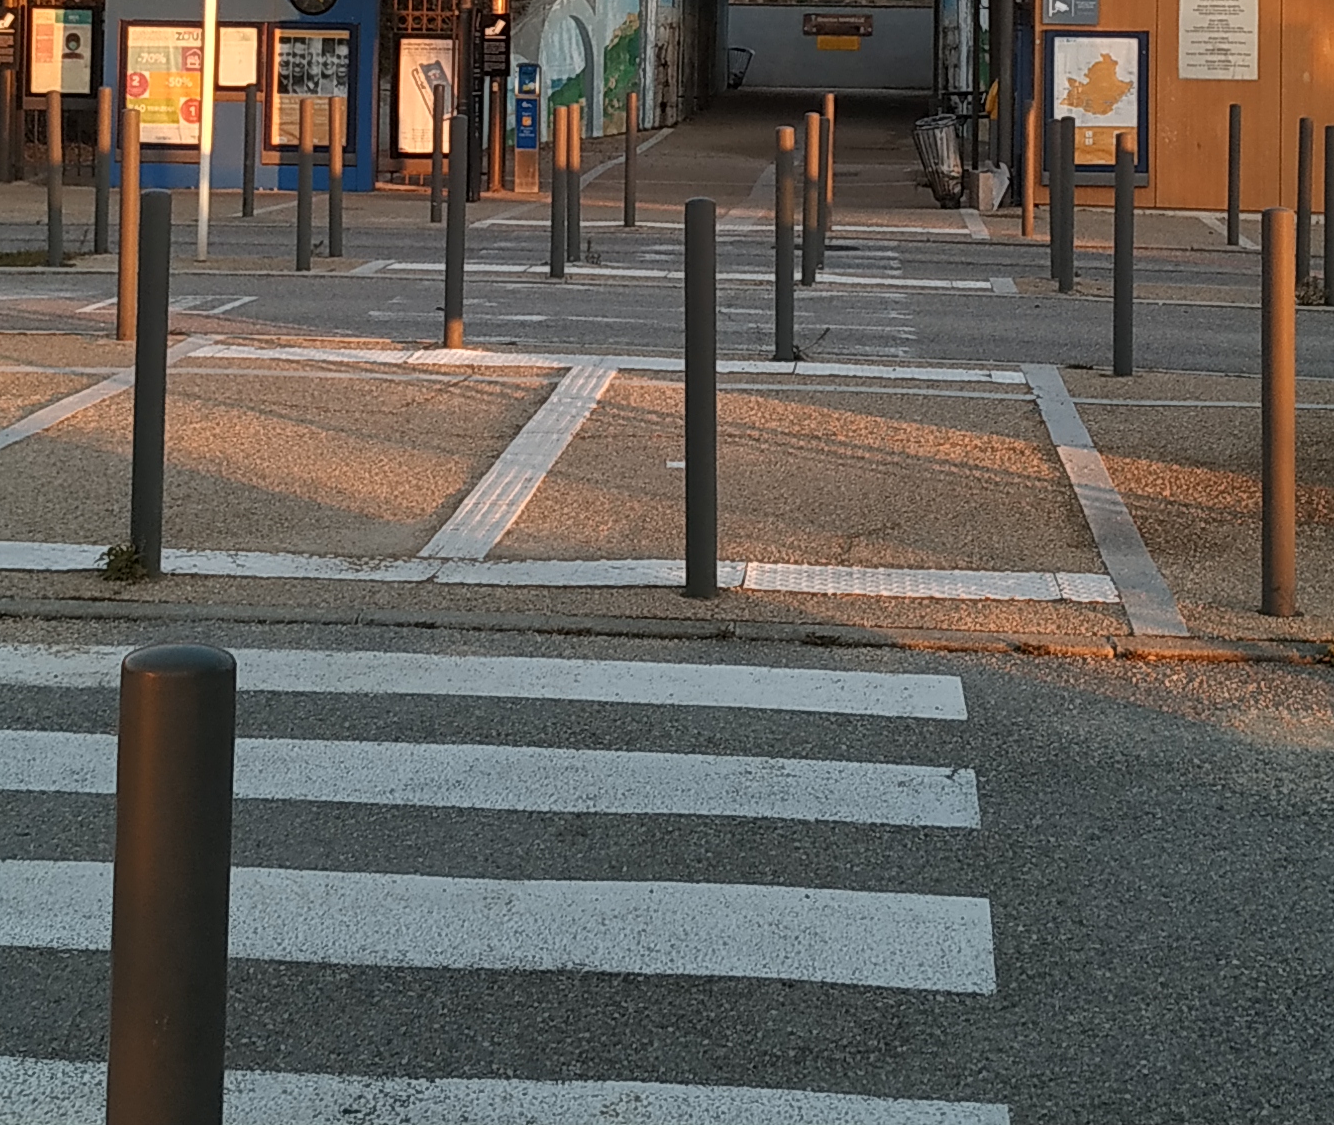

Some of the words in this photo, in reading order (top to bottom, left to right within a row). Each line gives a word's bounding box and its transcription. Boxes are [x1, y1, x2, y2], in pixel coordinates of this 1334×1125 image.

[137, 53, 167, 63] -70%
[132, 76, 140, 87] 2
[165, 77, 193, 87] -50%
